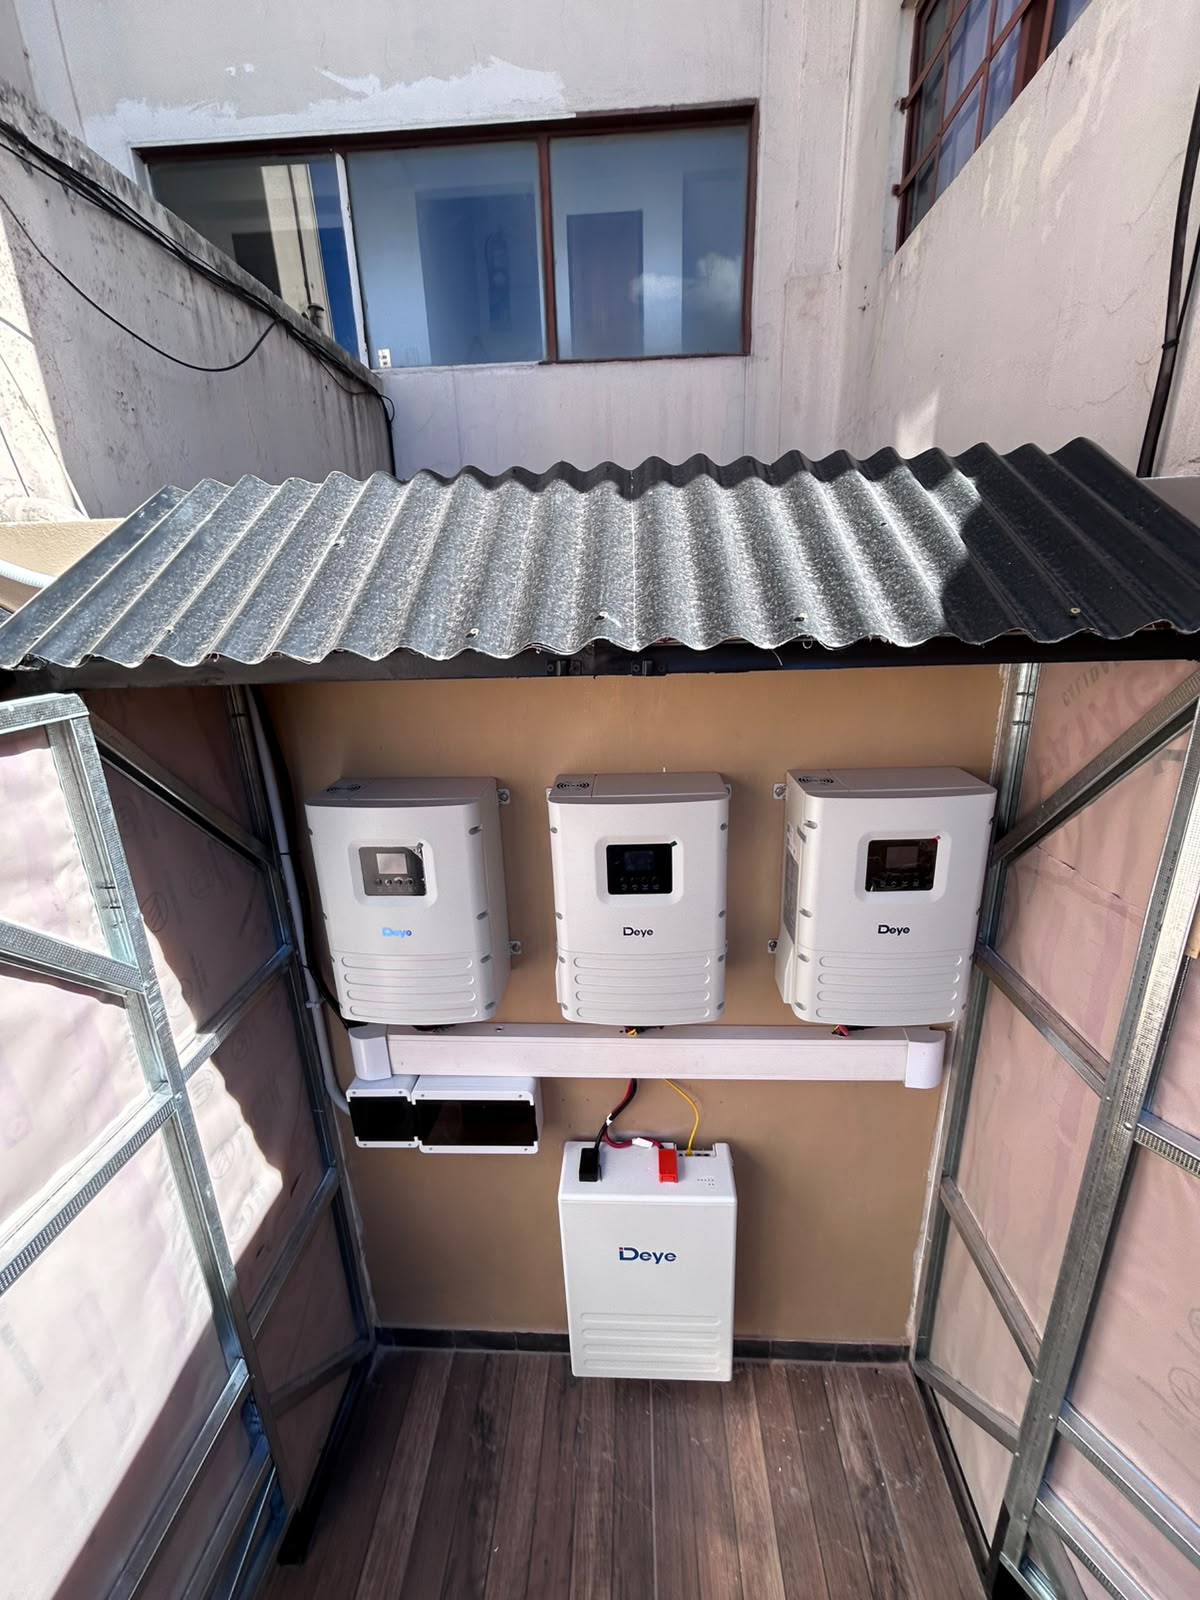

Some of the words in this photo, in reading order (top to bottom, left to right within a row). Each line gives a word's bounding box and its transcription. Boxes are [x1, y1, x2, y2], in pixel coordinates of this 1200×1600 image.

[622, 926, 654, 938] Deye
[877, 924, 911, 937] Deye
[618, 1246, 677, 1265] Deye
